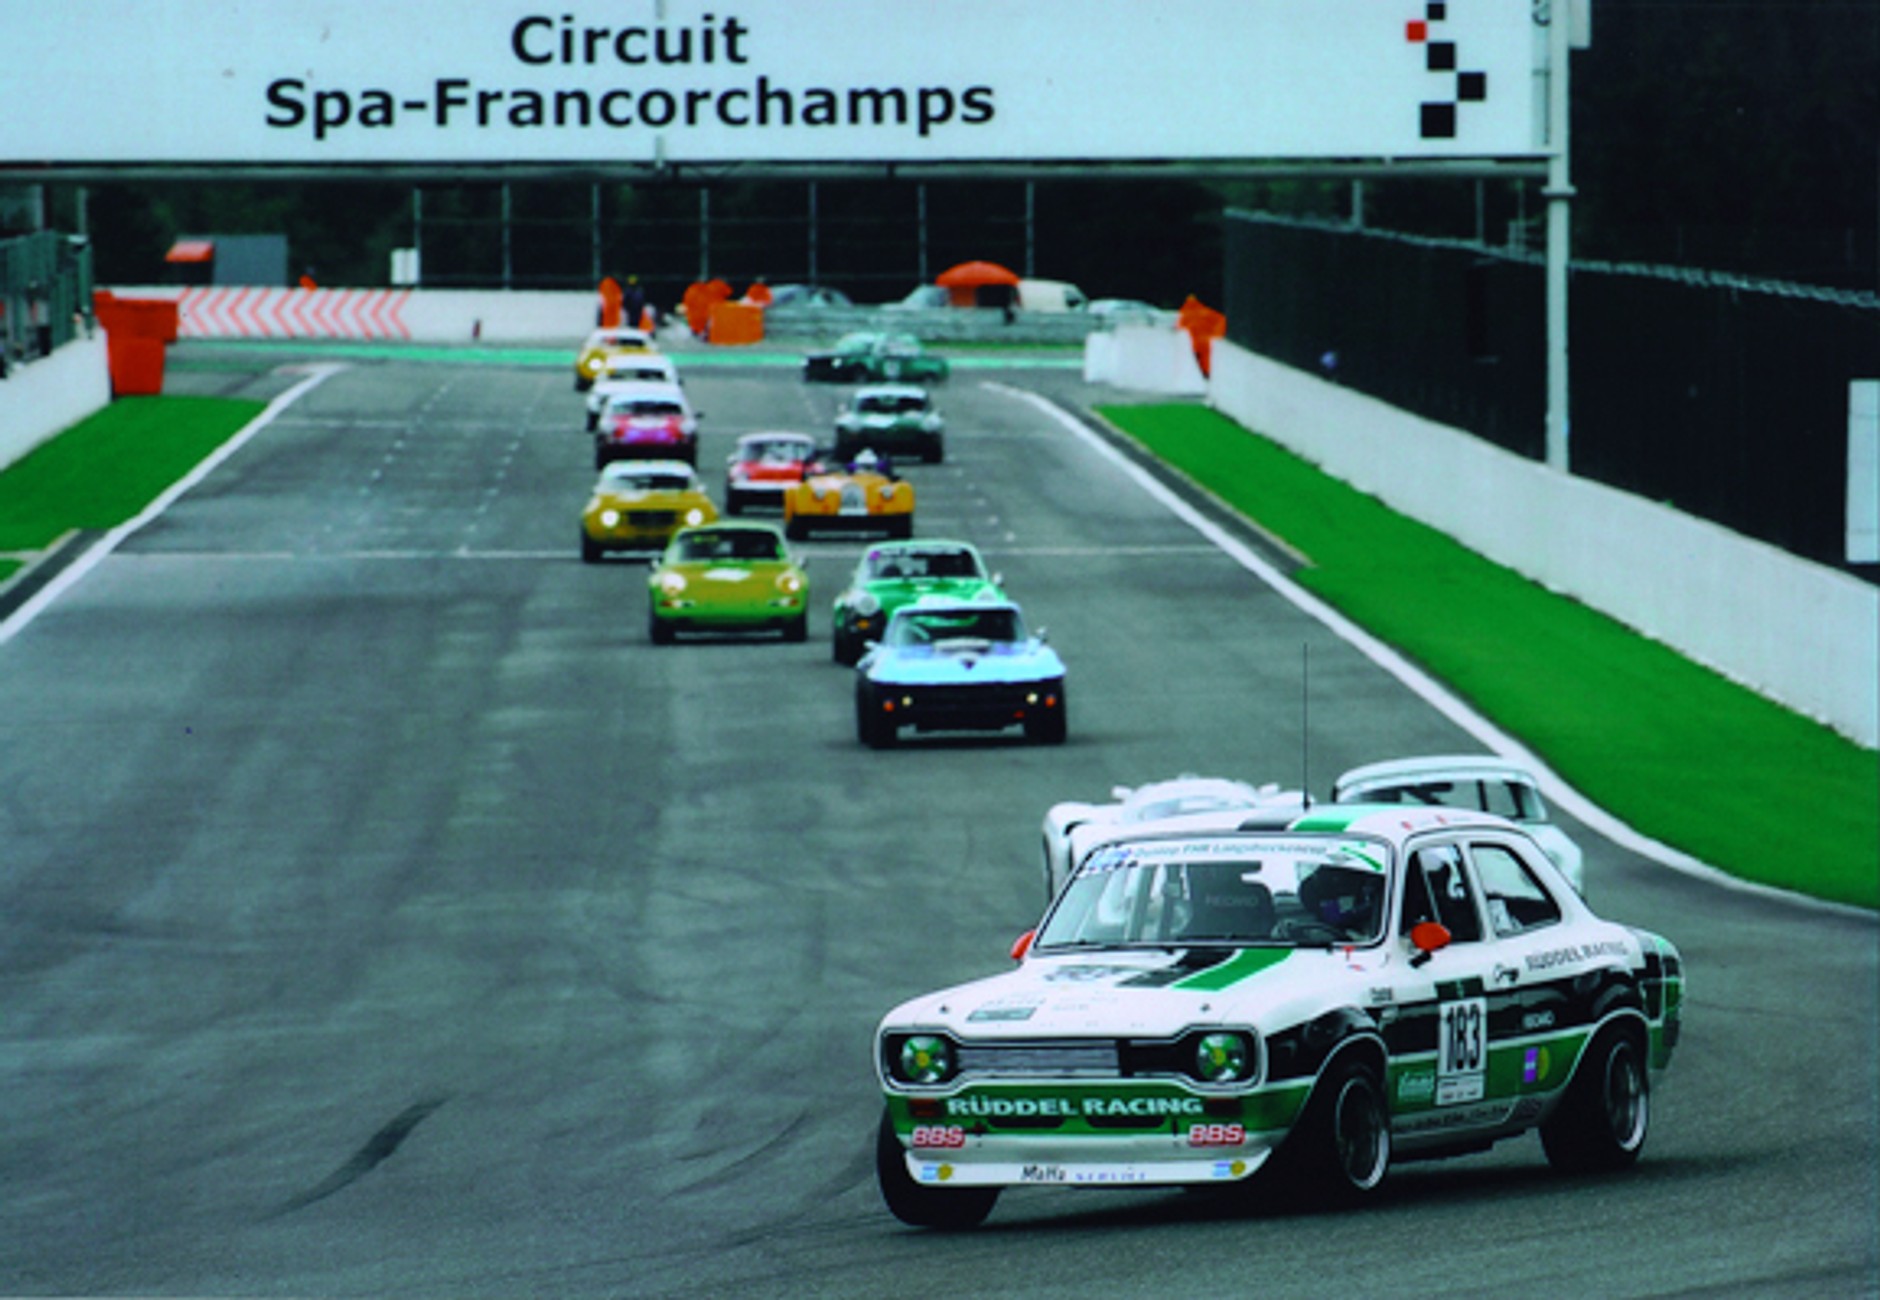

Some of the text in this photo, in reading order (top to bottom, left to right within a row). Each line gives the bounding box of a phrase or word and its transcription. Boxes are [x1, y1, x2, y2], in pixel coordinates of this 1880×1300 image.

[512, 14, 747, 65] Circuit
[266, 76, 994, 140] Spa-Francorchamps
[1446, 1003, 1481, 1073] 183
[946, 1096, 1204, 1116] RÜDDEL RACING
[912, 1126, 964, 1147] BBS
[1187, 1124, 1246, 1146] BBS
